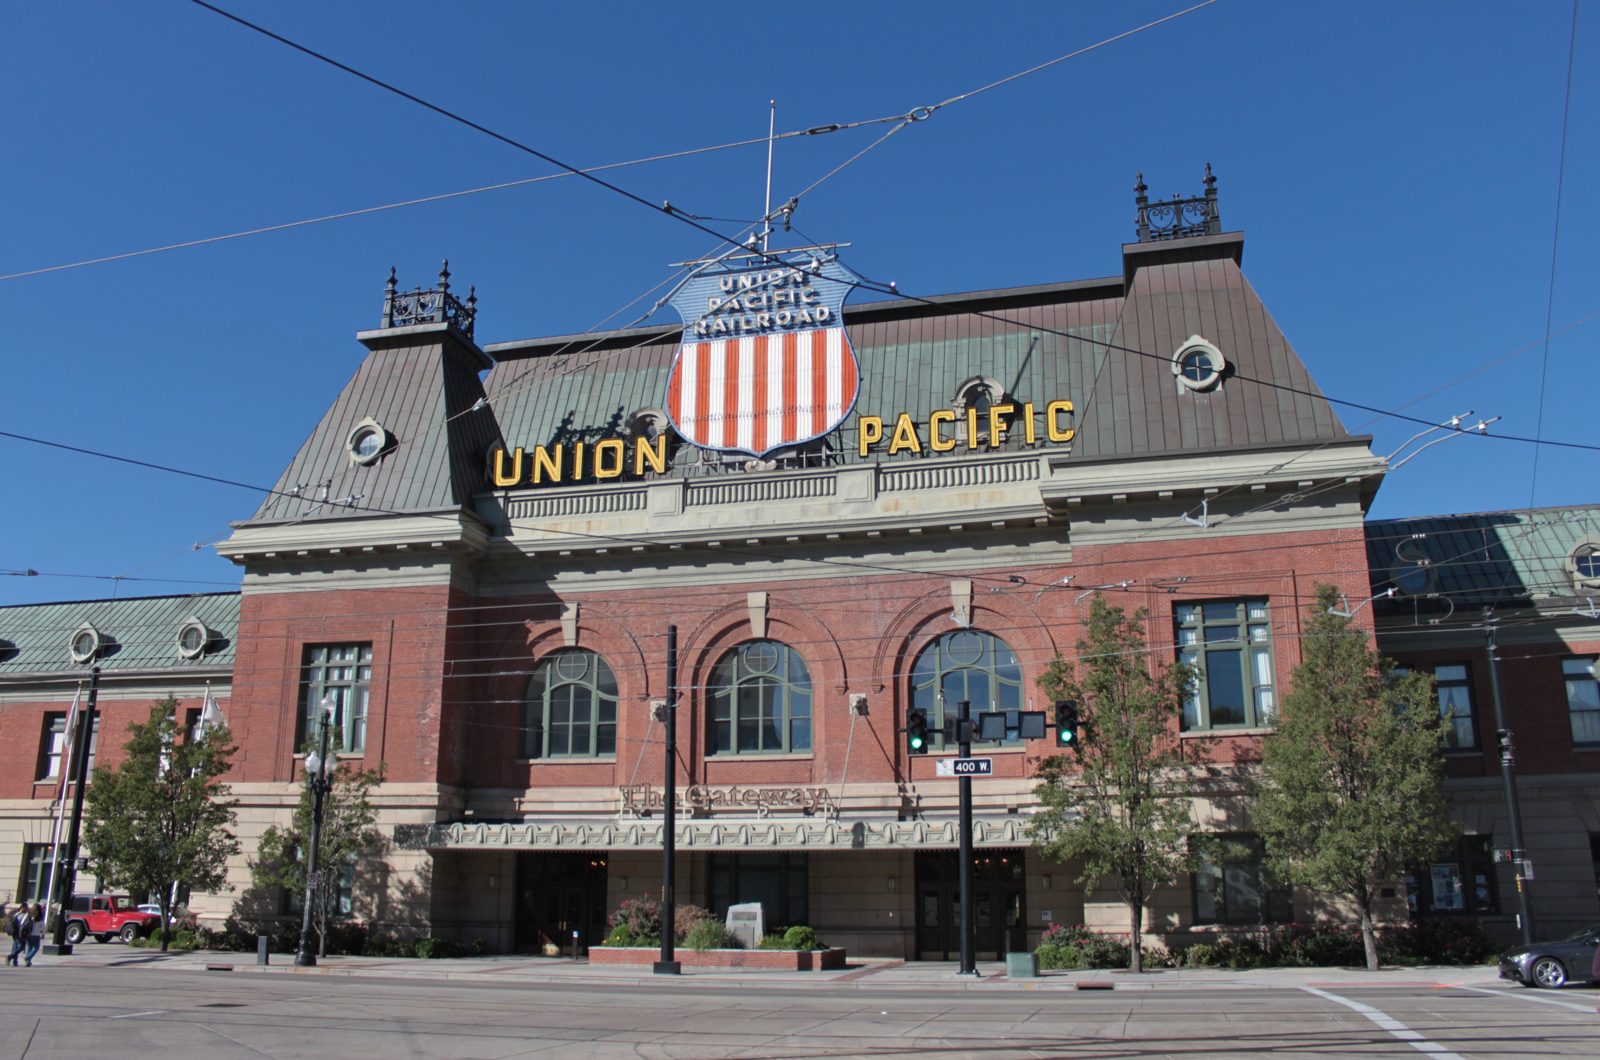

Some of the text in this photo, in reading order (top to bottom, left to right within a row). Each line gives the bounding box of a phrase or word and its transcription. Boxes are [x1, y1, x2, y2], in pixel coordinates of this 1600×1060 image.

[719, 268, 804, 291] UNION
[707, 286, 815, 311] PACIFIC
[693, 305, 830, 335] RAILROAD
[492, 399, 1076, 487] UNION PACIFIC
[956, 762, 975, 772] 400
[685, 783, 828, 813] Gateway
